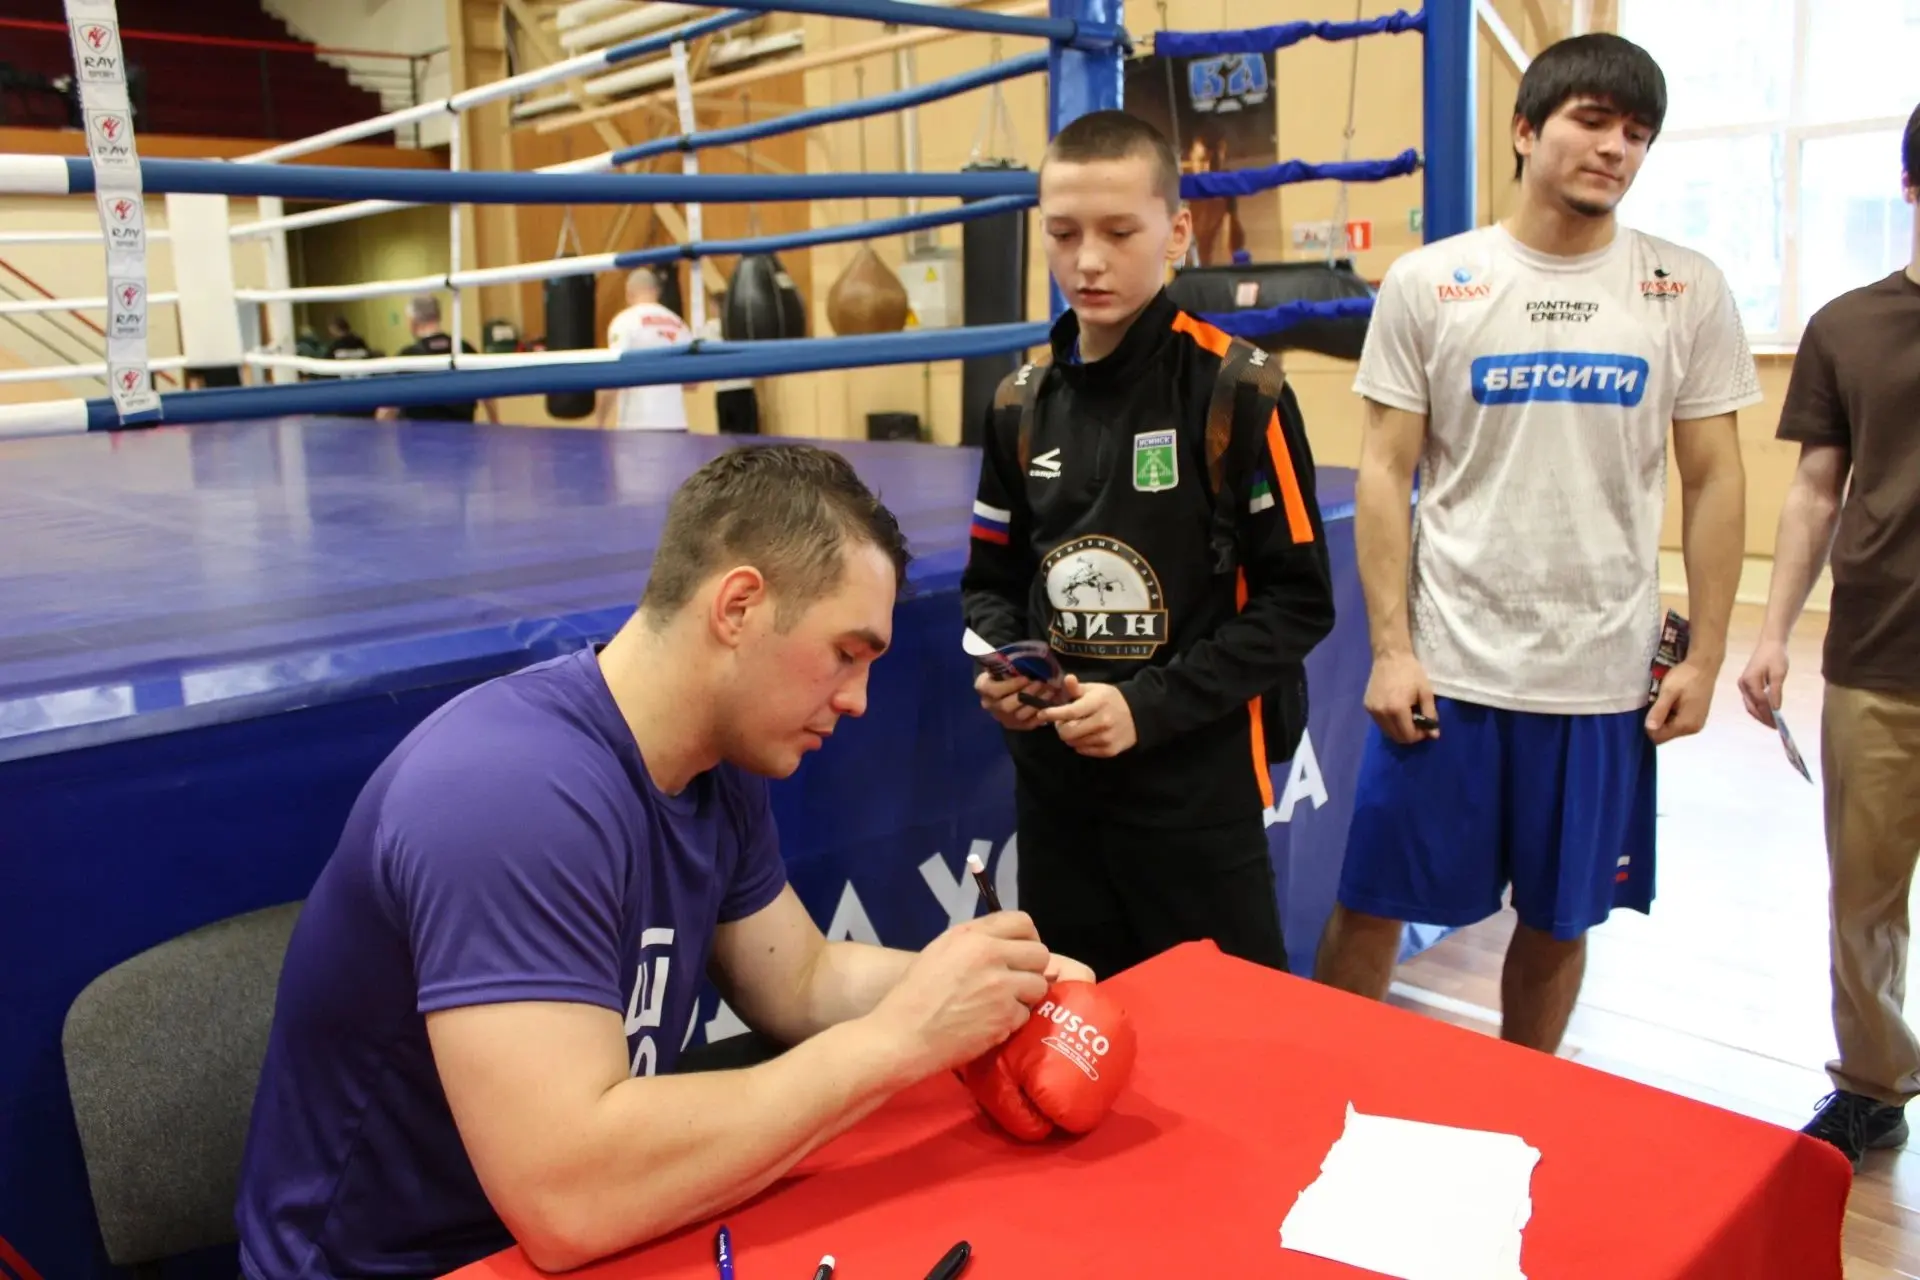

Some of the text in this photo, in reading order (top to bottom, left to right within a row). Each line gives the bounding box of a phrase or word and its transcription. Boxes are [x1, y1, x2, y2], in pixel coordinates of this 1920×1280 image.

[84, 56, 117, 69] RAY
[112, 227, 141, 239] RAY
[1437, 284, 1491, 300] TASSAY
[1526, 301, 1599, 312] PANTHER
[115, 313, 144, 325] RAY
[1531, 311, 1592, 323] ENERGY
[1484, 363, 1639, 393] БЕТСИТИ
[1037, 1000, 1110, 1056] RUSCO
